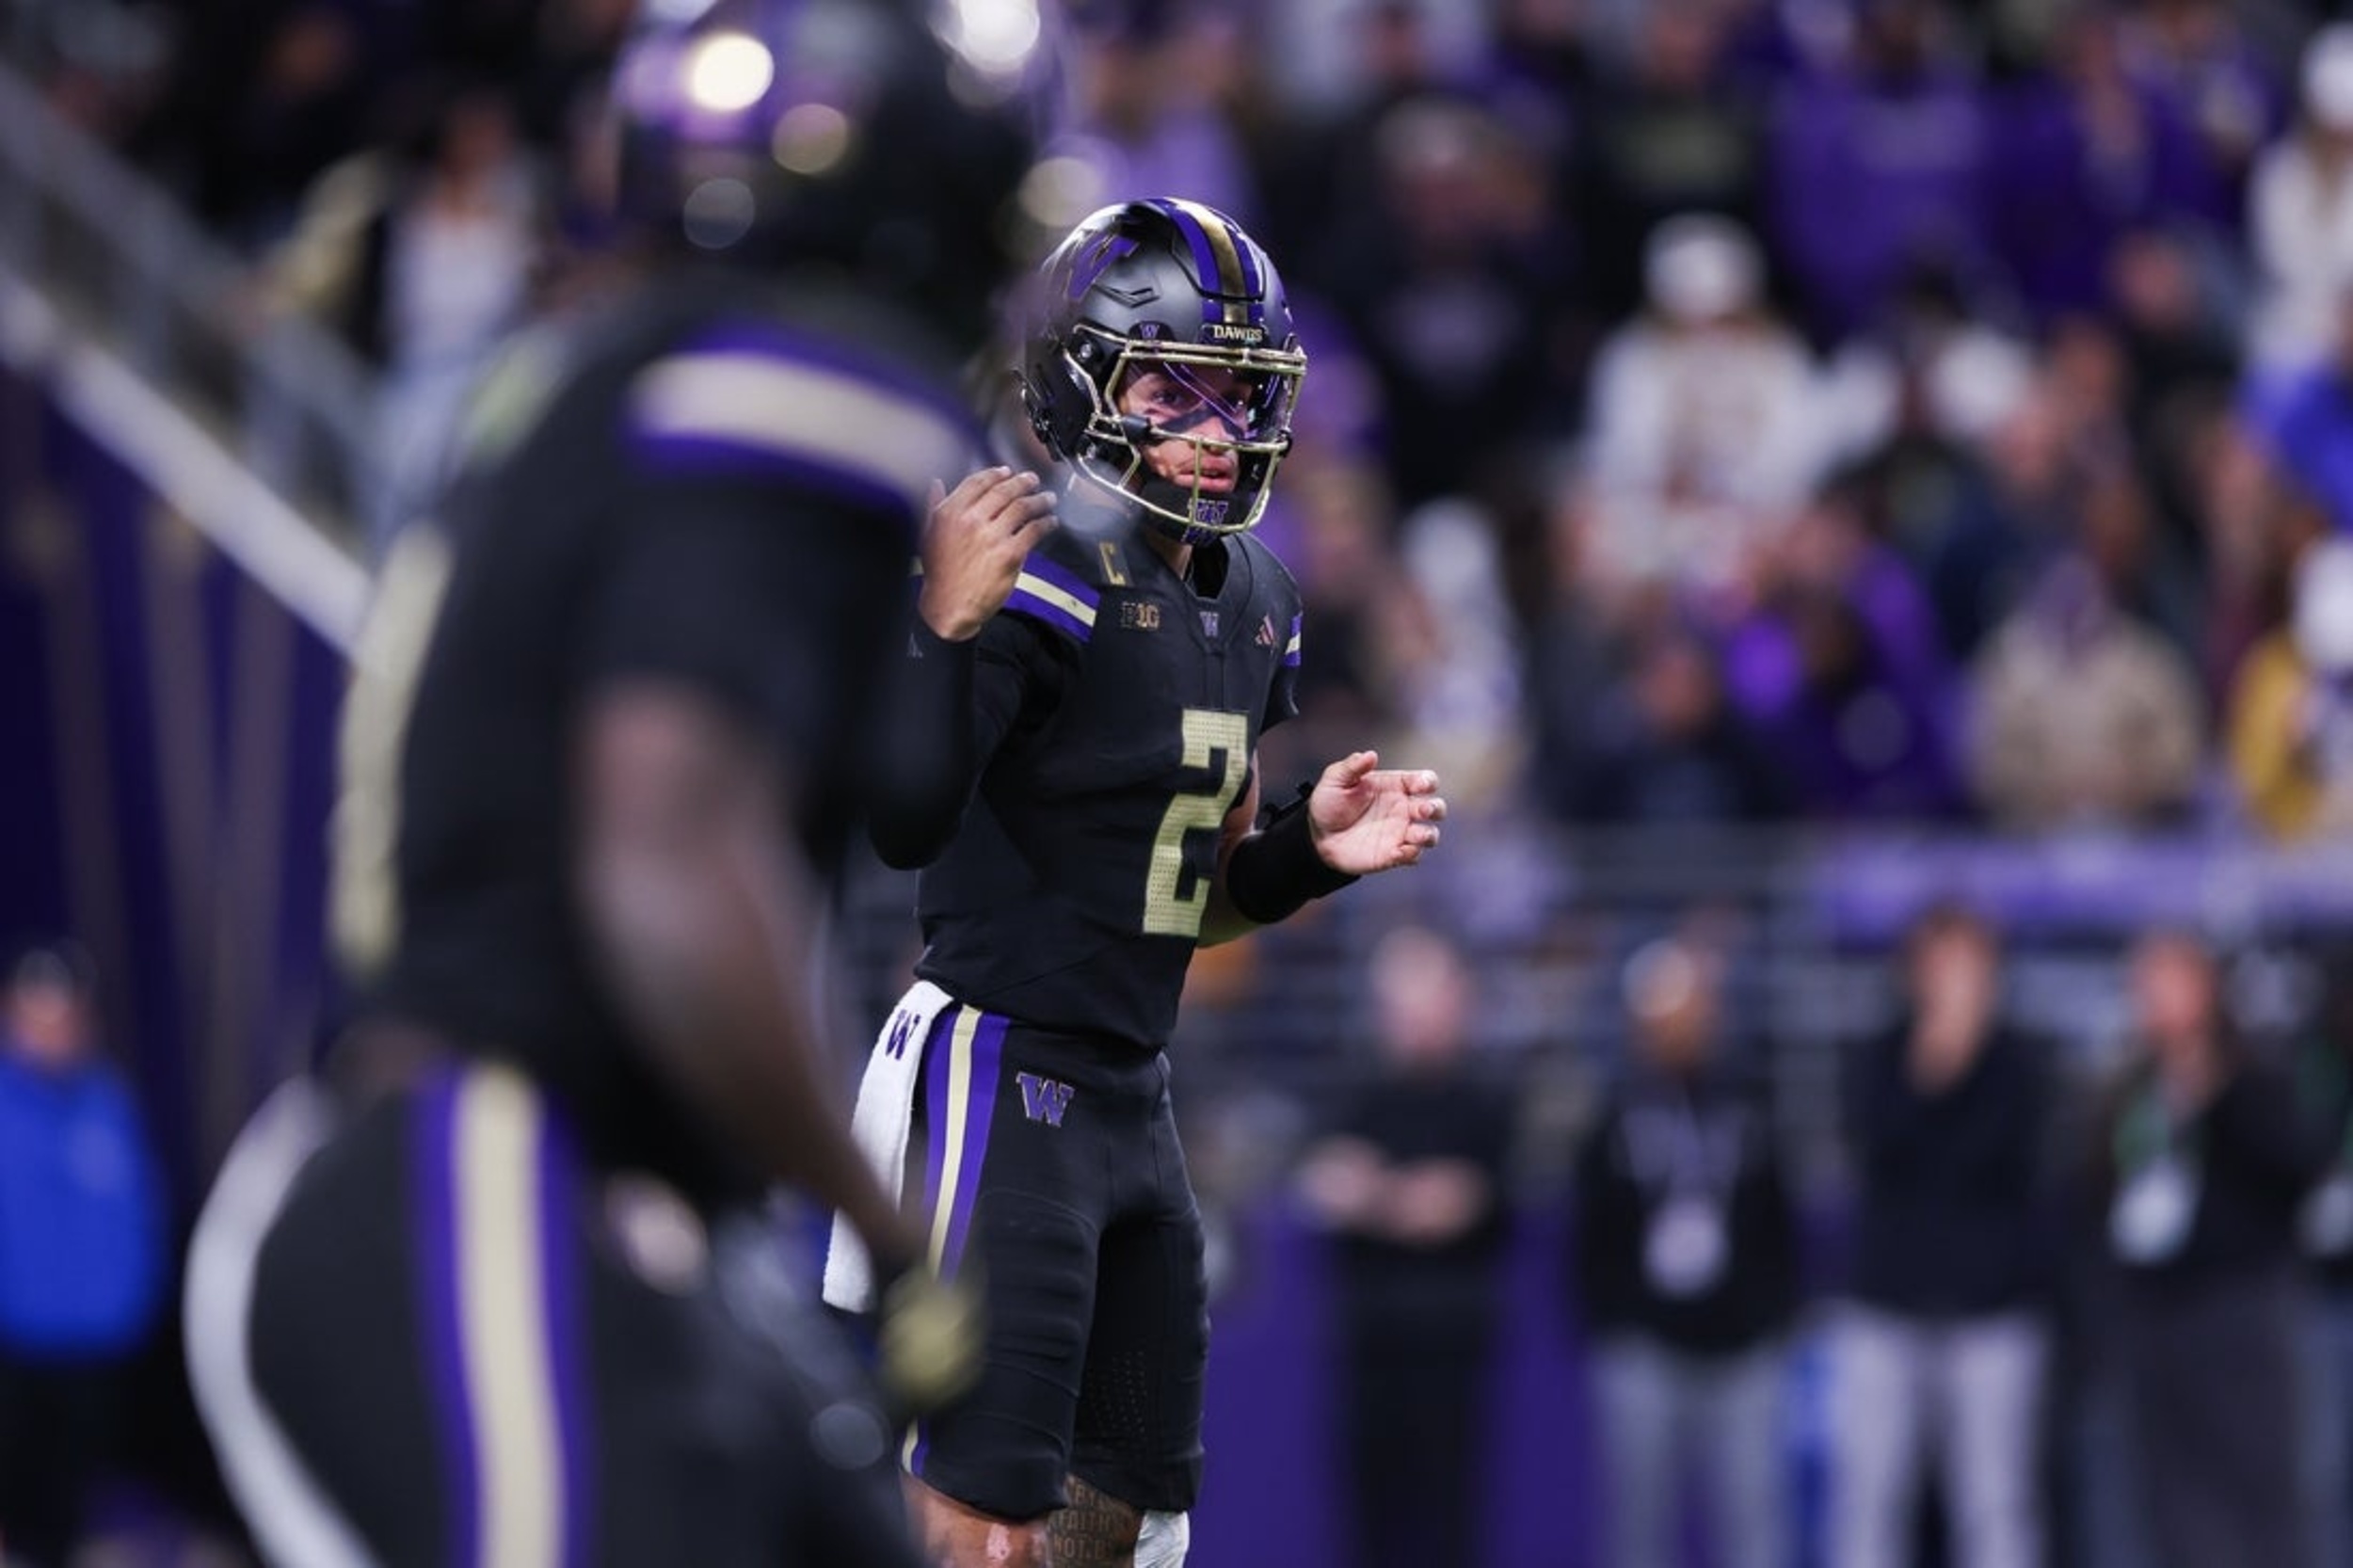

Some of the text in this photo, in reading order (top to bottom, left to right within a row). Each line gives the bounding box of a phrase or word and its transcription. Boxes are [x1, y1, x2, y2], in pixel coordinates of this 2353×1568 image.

[1213, 325, 1263, 342] DAWGS
[1099, 542, 1126, 585] C
[1199, 611, 1219, 638] W
[1143, 709, 1248, 936] 2
[885, 1009, 920, 1061] W
[1016, 1070, 1075, 1128] W
[1058, 1509, 1111, 1532] FAITH
